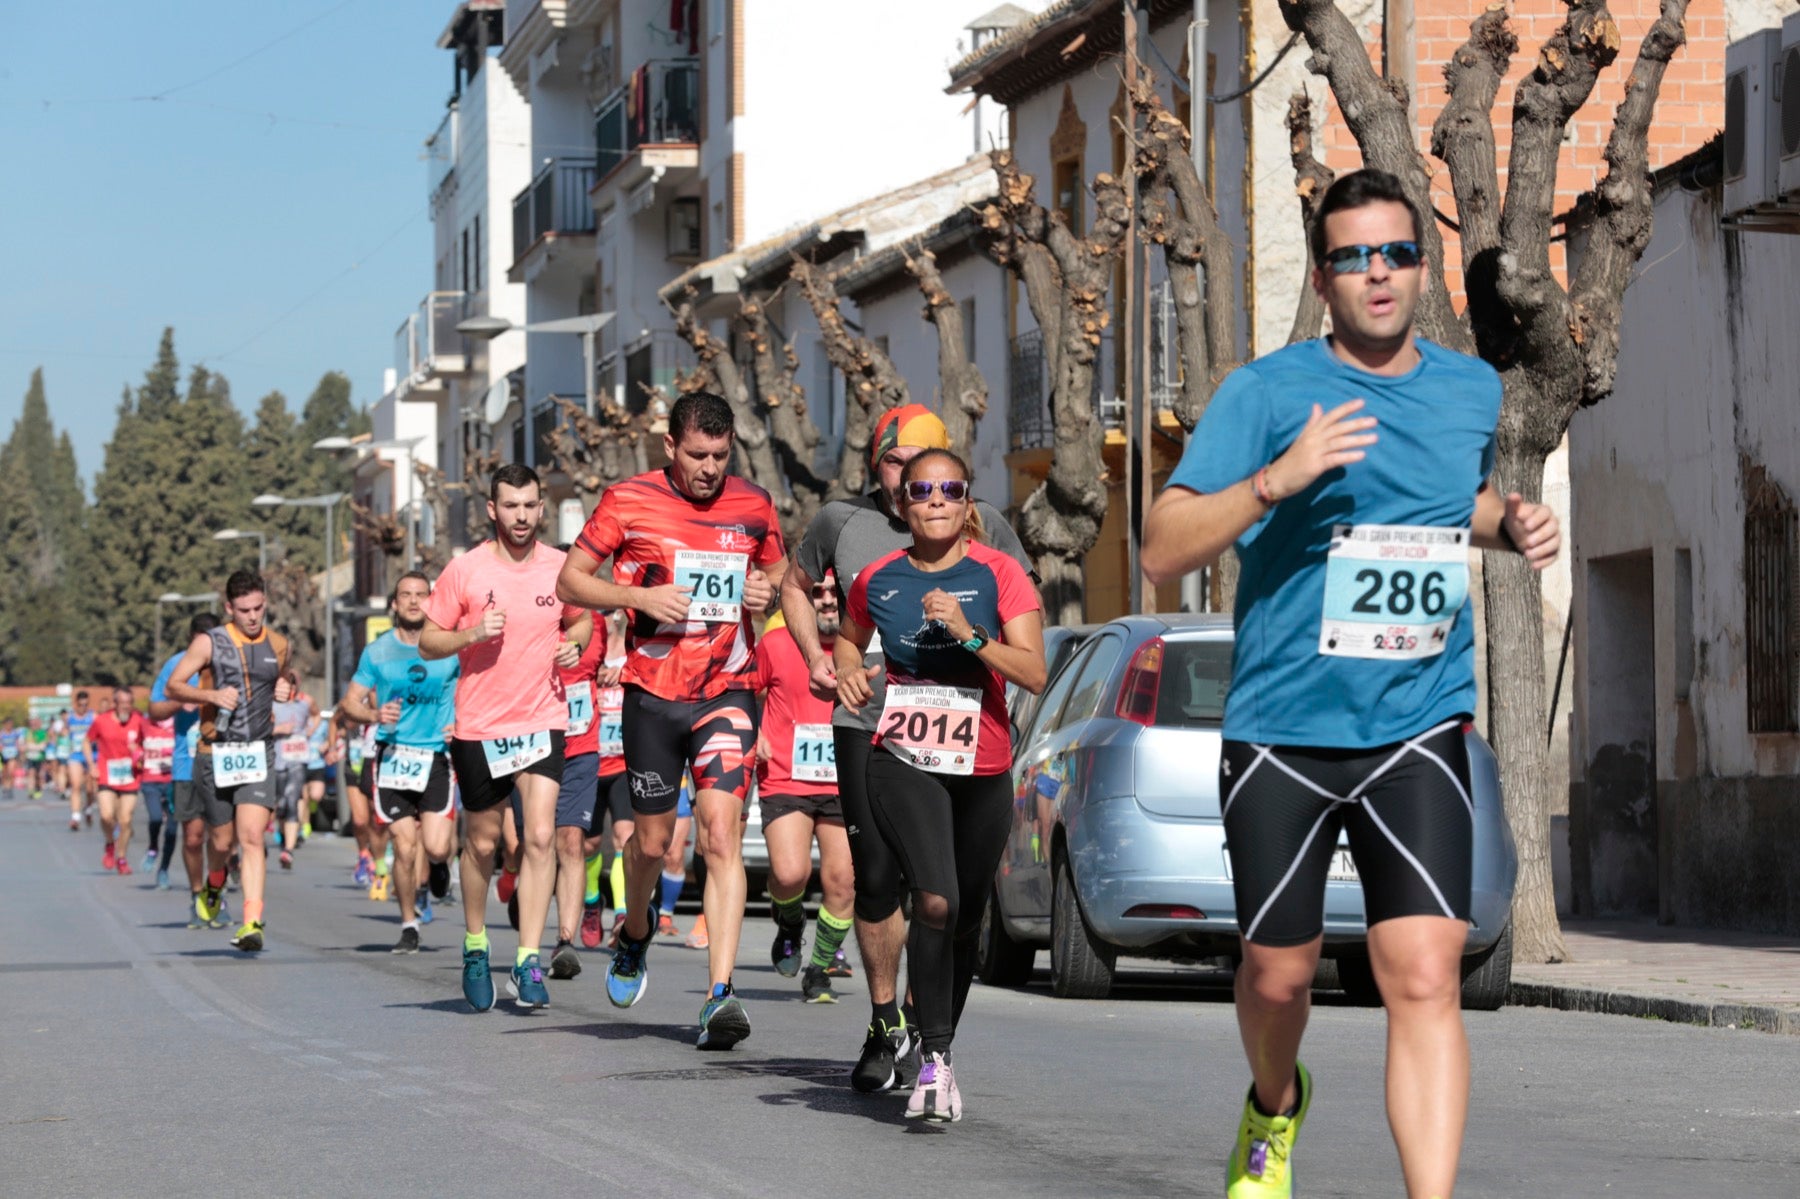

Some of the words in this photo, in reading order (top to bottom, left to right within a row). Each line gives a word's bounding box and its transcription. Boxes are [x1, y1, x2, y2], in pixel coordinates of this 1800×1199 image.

[1370, 531, 1391, 542] GRAN
[1394, 532, 1423, 544] PREMIO
[1426, 534, 1435, 544] DE
[689, 573, 734, 599] 761
[1352, 568, 1446, 616] 286
[535, 595, 555, 607] GO
[909, 687, 924, 696] GRAN
[924, 688, 948, 698] PREMIO
[948, 689, 956, 698] DE
[915, 696, 951, 707] DIPUTACIÓN
[883, 711, 974, 747] 2014
[223, 755, 257, 771] 802
[390, 759, 422, 776] 192
